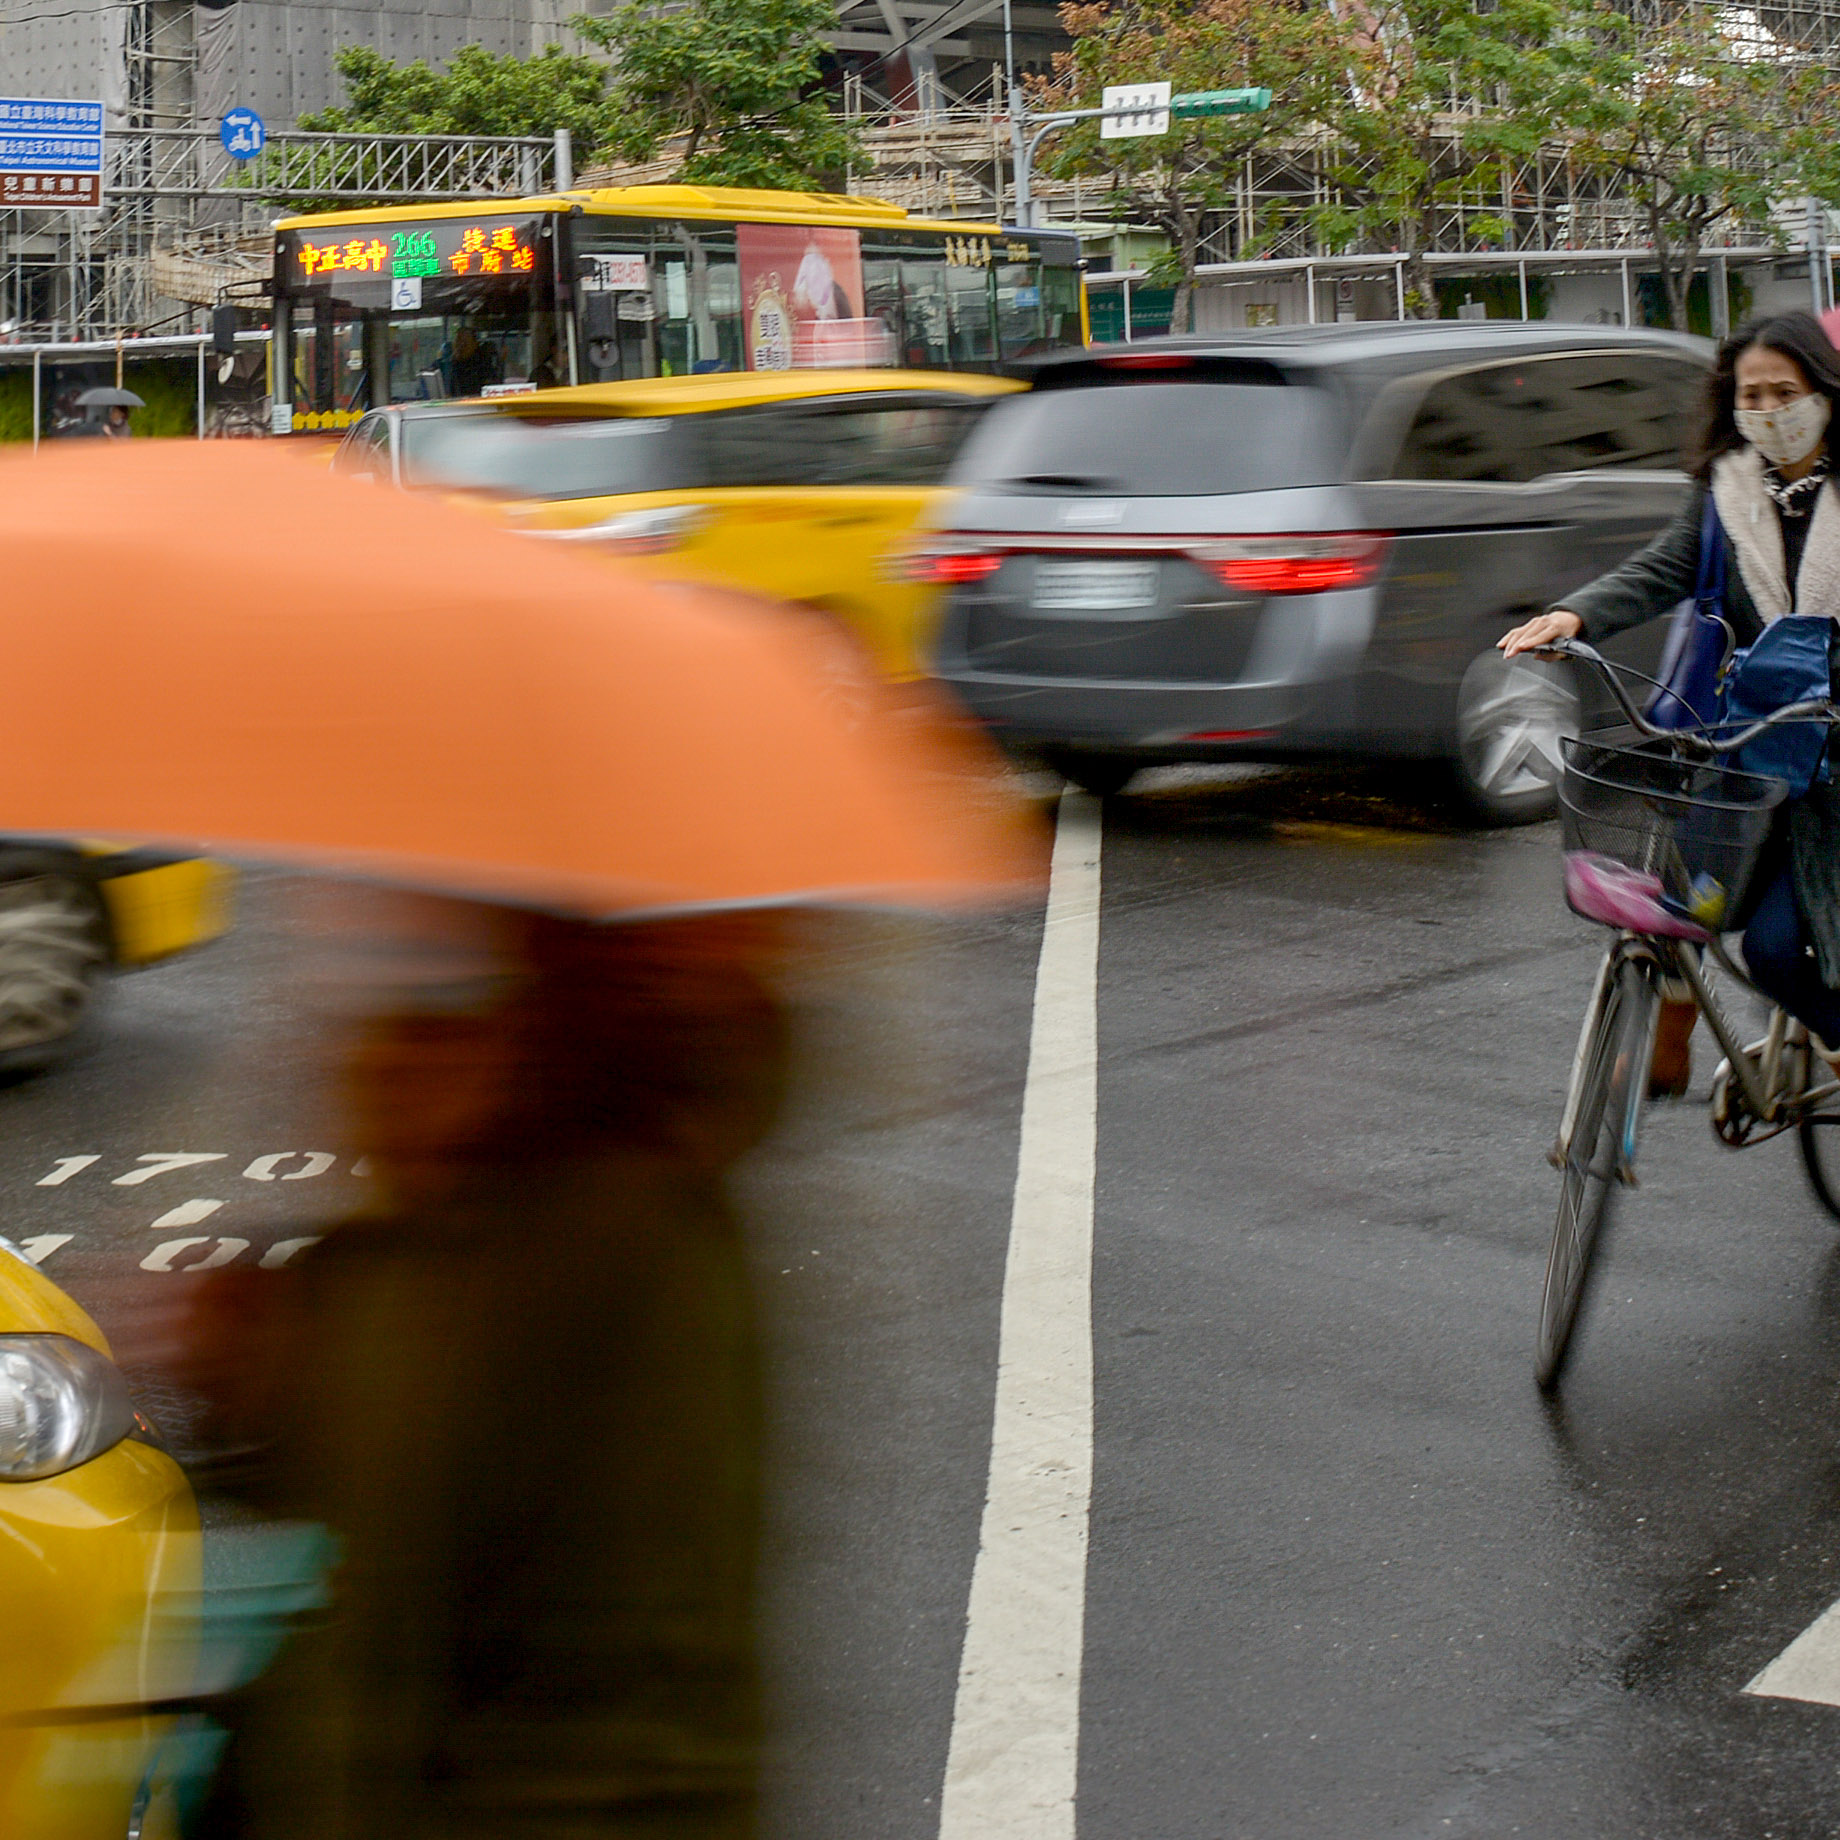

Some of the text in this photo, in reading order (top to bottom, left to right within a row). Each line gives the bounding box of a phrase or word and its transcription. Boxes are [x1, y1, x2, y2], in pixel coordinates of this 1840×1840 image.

[3, 176, 92, 192] 兒童新樂園
[391, 230, 437, 257] 266
[462, 226, 518, 253] 捷運
[297, 238, 389, 276] 中正高中
[448, 245, 535, 275] 市府站
[34, 1150, 373, 1187] 170
